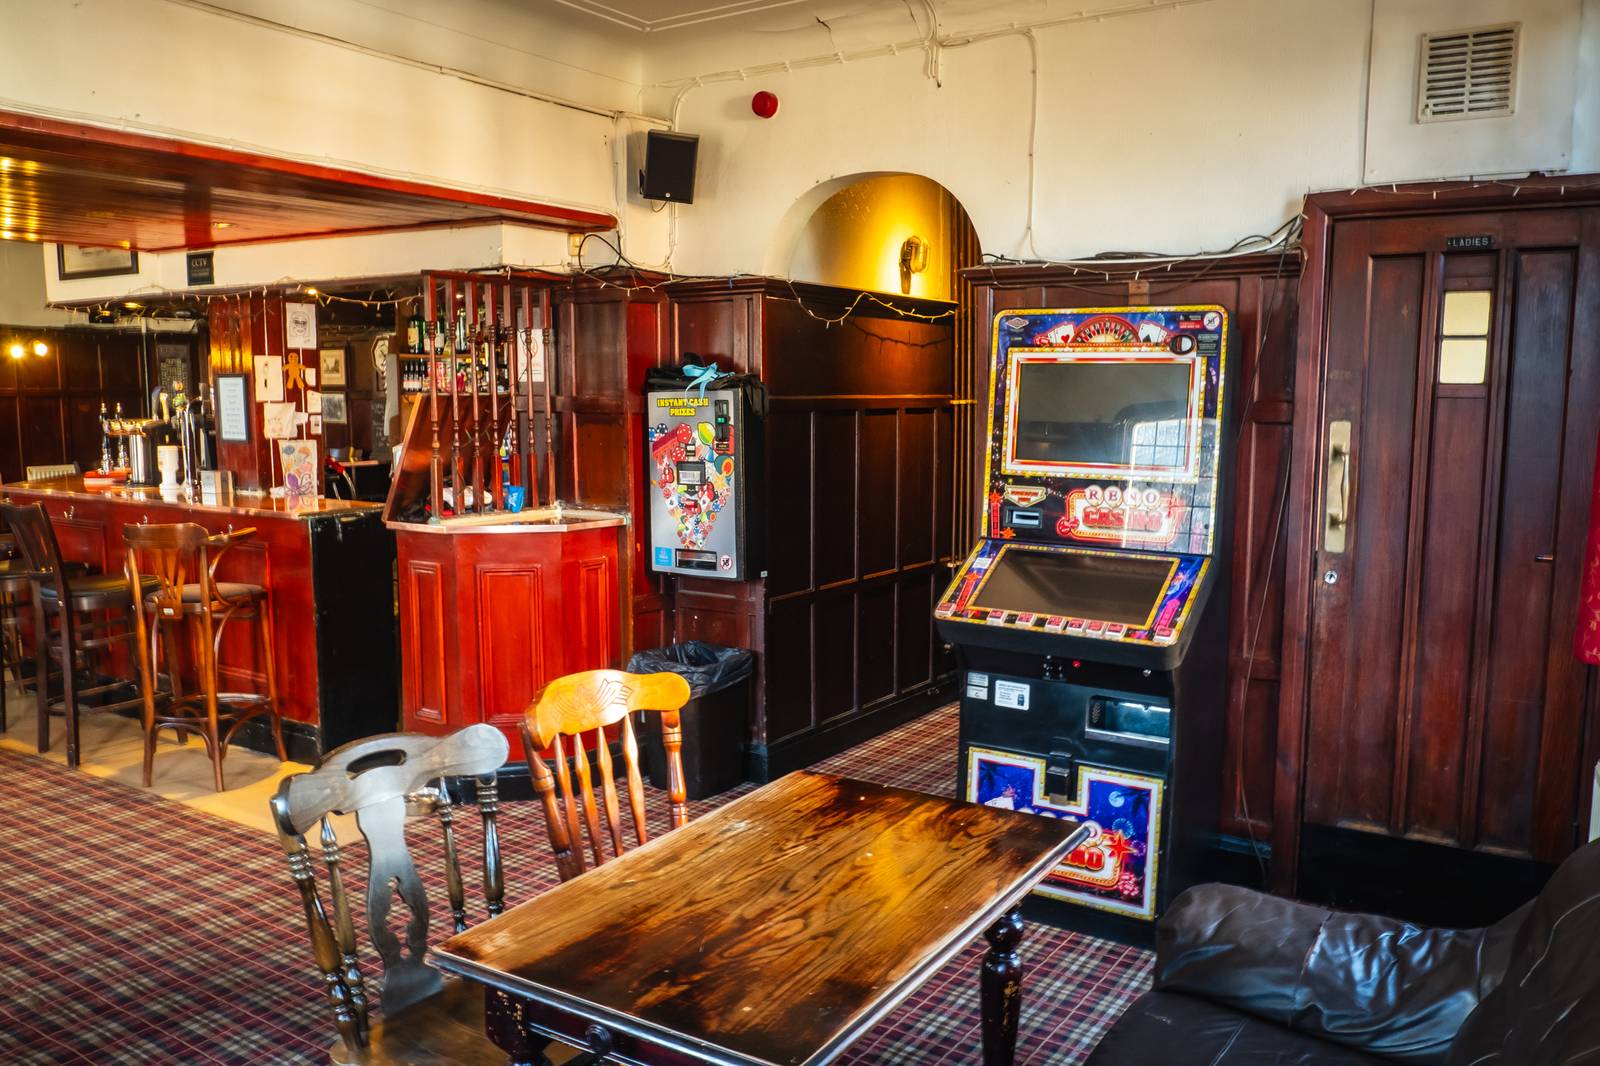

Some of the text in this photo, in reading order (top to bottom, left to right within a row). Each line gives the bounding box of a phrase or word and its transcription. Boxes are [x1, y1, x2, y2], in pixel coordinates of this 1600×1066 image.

[1453, 237, 1489, 247] LADIES
[657, 398, 687, 407] INSTANT
[670, 408, 696, 416] PRIZES
[1087, 487, 1160, 506] RENO
[1082, 506, 1163, 531] CASINO
